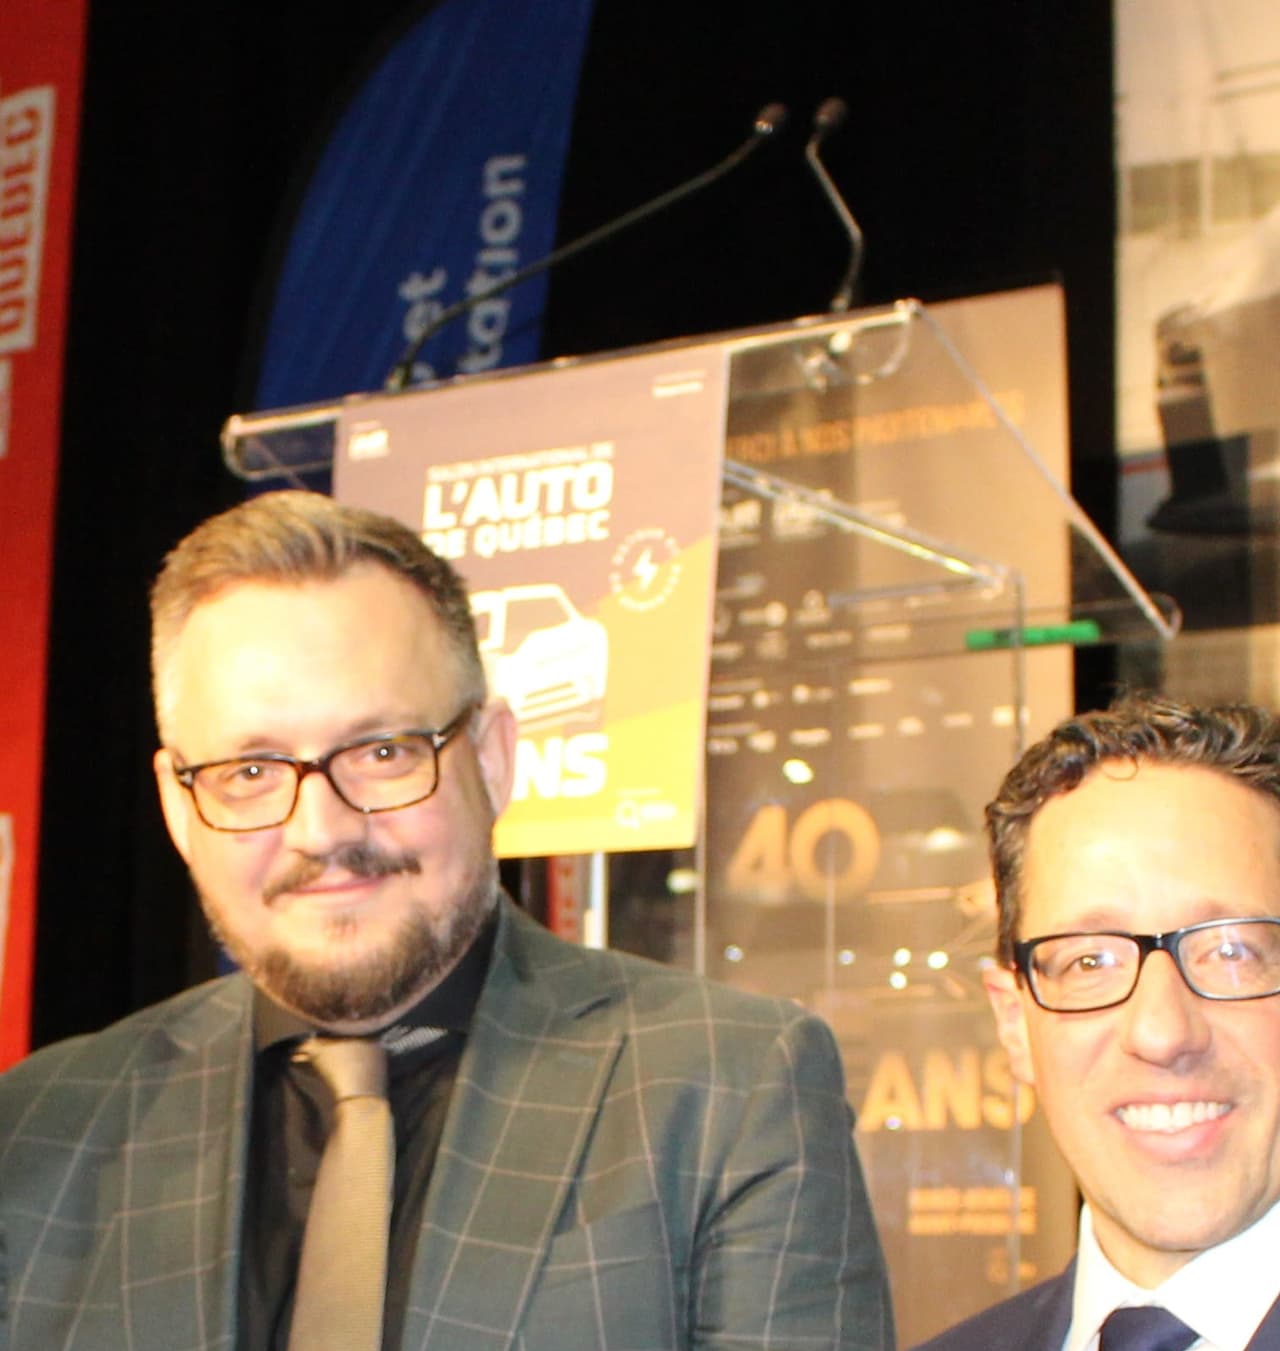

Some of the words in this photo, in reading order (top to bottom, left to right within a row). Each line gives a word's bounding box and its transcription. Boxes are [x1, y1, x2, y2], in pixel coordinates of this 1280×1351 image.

[423, 460, 614, 529] L'AUTO
[472, 511, 611, 559] QUÉBEC
[513, 732, 610, 801] NS
[728, 798, 881, 904] 40
[858, 1046, 1037, 1132] ANS
